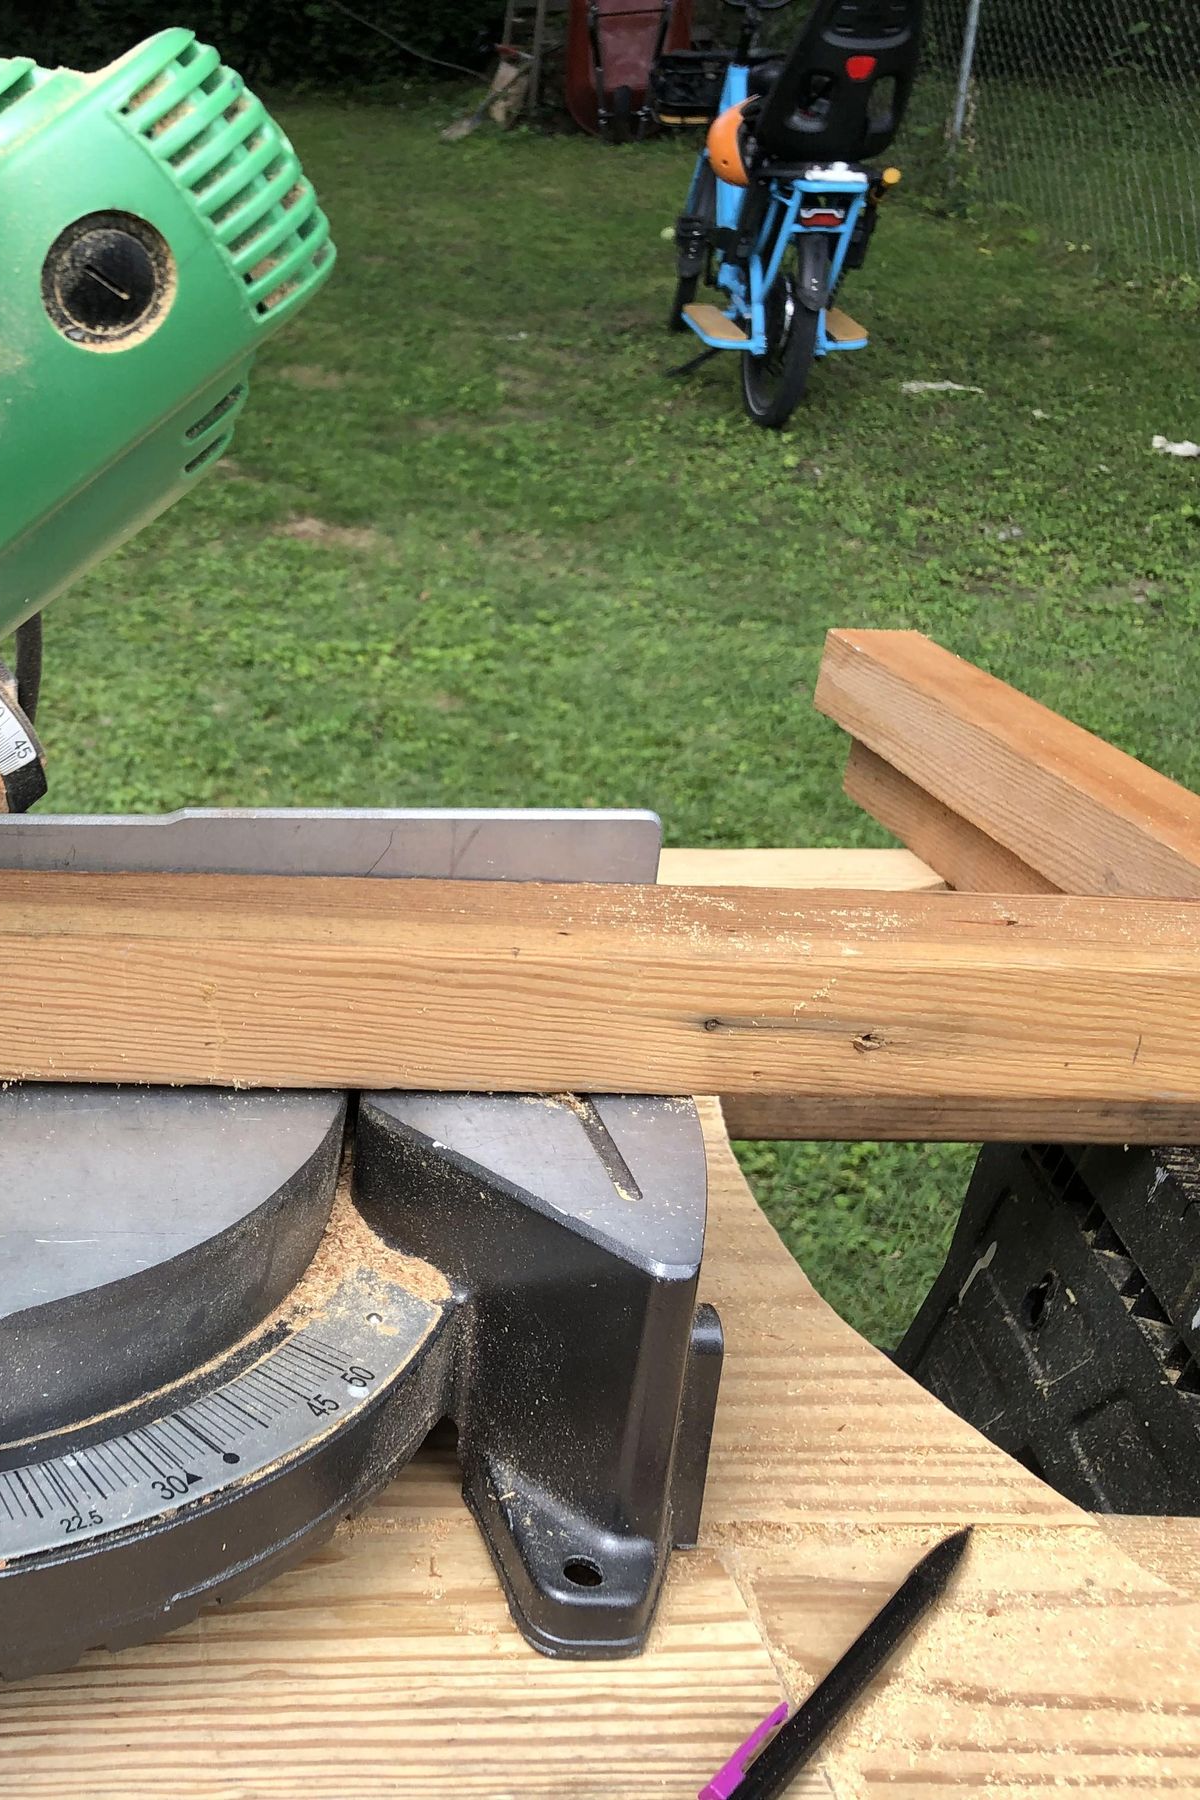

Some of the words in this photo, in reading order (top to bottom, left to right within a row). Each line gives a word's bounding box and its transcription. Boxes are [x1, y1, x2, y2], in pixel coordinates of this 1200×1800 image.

[13, 740, 33, 760] 45
[340, 1366, 376, 1388] 50
[307, 1394, 340, 1417] 45
[151, 1475, 190, 1501] 30
[59, 1509, 104, 1534] 22.5
